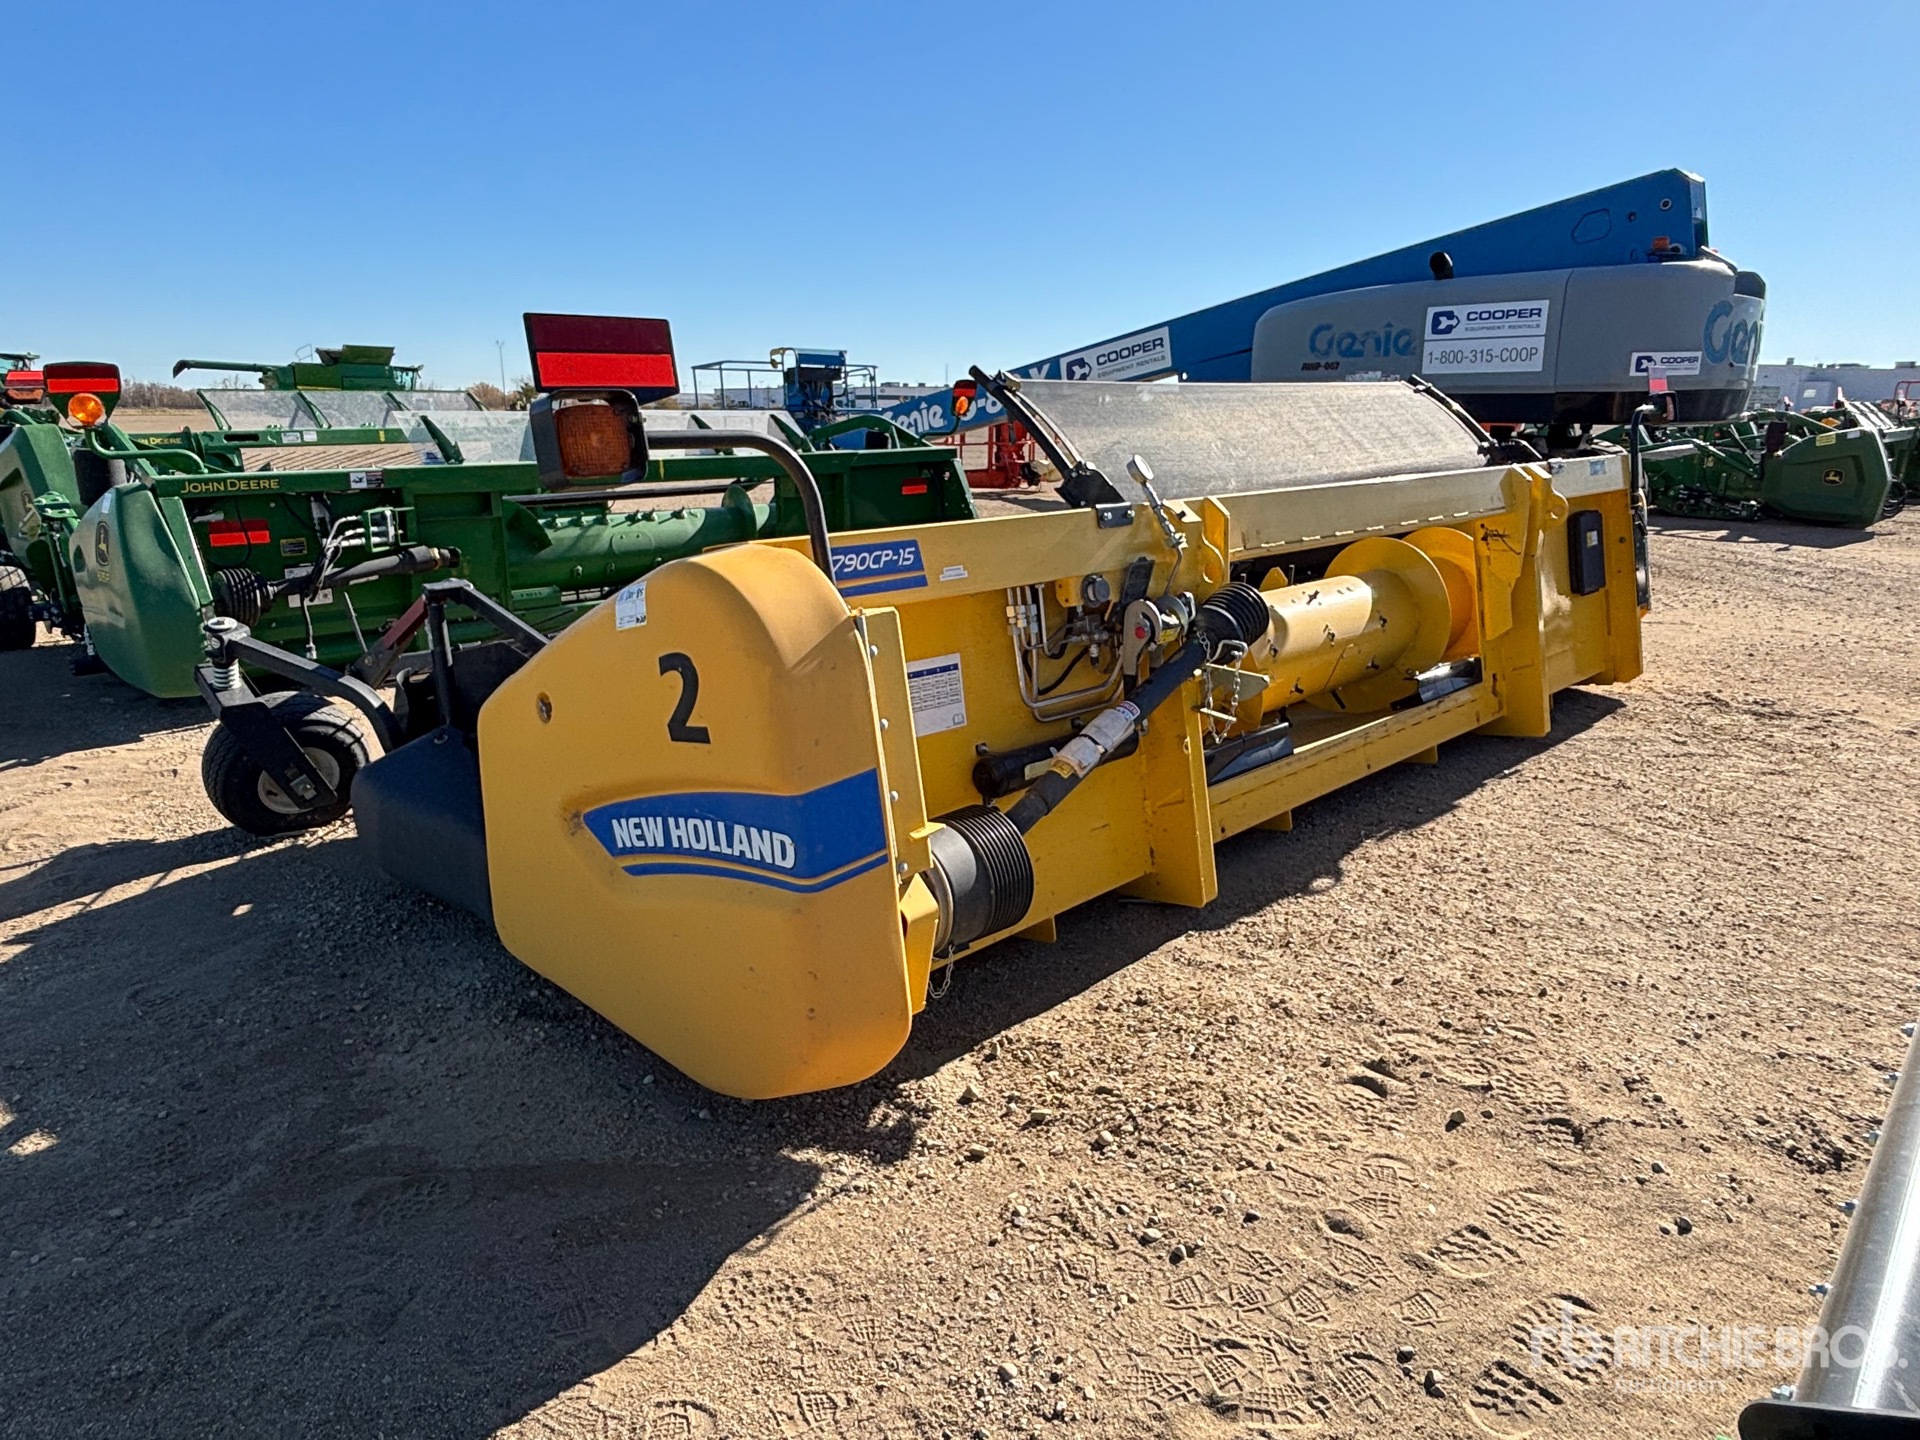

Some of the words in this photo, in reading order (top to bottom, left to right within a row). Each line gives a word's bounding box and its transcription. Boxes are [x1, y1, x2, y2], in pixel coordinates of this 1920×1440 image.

[1466, 308, 1542, 321] COOPER
[1310, 322, 1416, 358] Genie
[1096, 337, 1164, 366] COOPER
[1427, 347, 1538, 364] 1-800-315-COOP
[1660, 356, 1699, 364] COOPER
[149, 437, 182, 445] DEERE
[181, 481, 225, 493] JOHN
[227, 478, 280, 490] DEERE
[832, 547, 916, 573] 790CP-15
[659, 652, 711, 744] 2
[612, 816, 664, 848] NEW
[668, 817, 796, 869] HOLLAND
